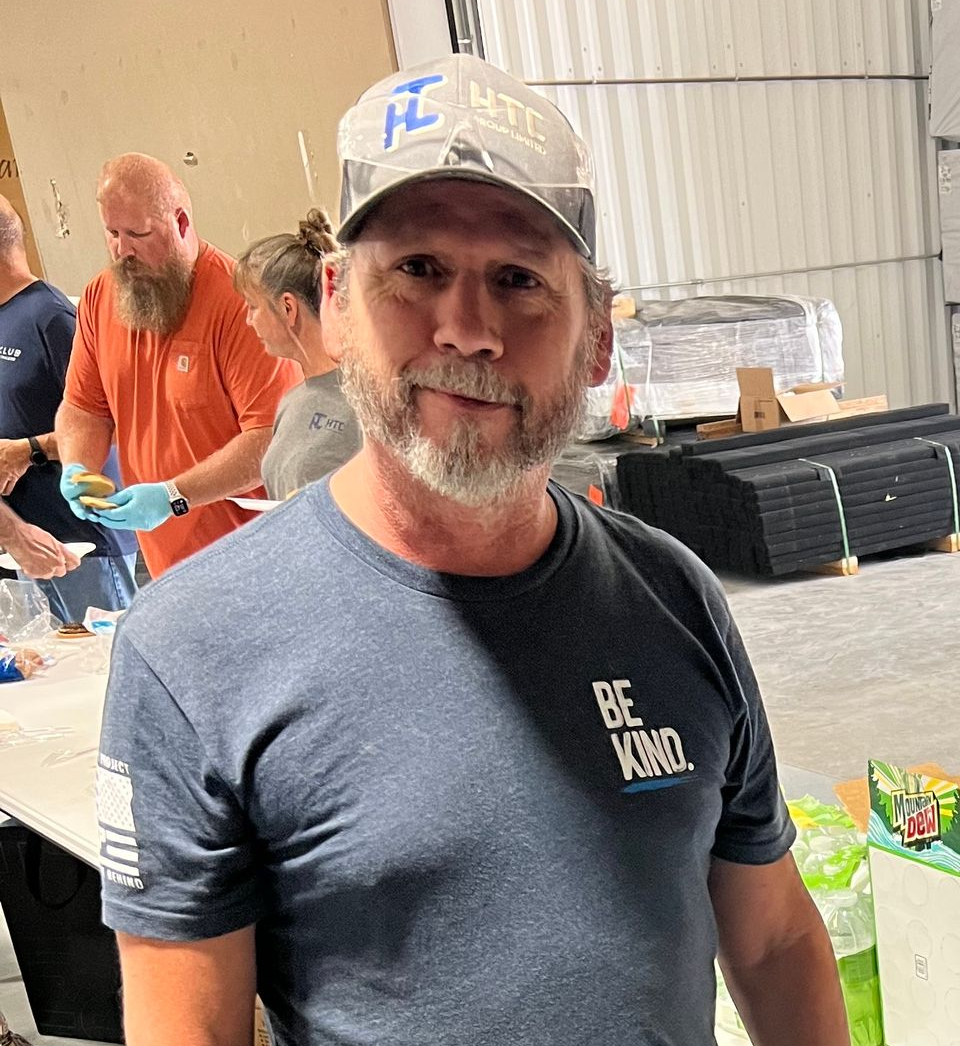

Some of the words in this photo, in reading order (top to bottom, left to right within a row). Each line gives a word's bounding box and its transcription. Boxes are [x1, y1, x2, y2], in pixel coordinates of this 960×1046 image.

[470, 80, 547, 141] HTC
[326, 419, 345, 432] HTC
[592, 679, 644, 729] BE
[610, 727, 695, 781] KIND.
